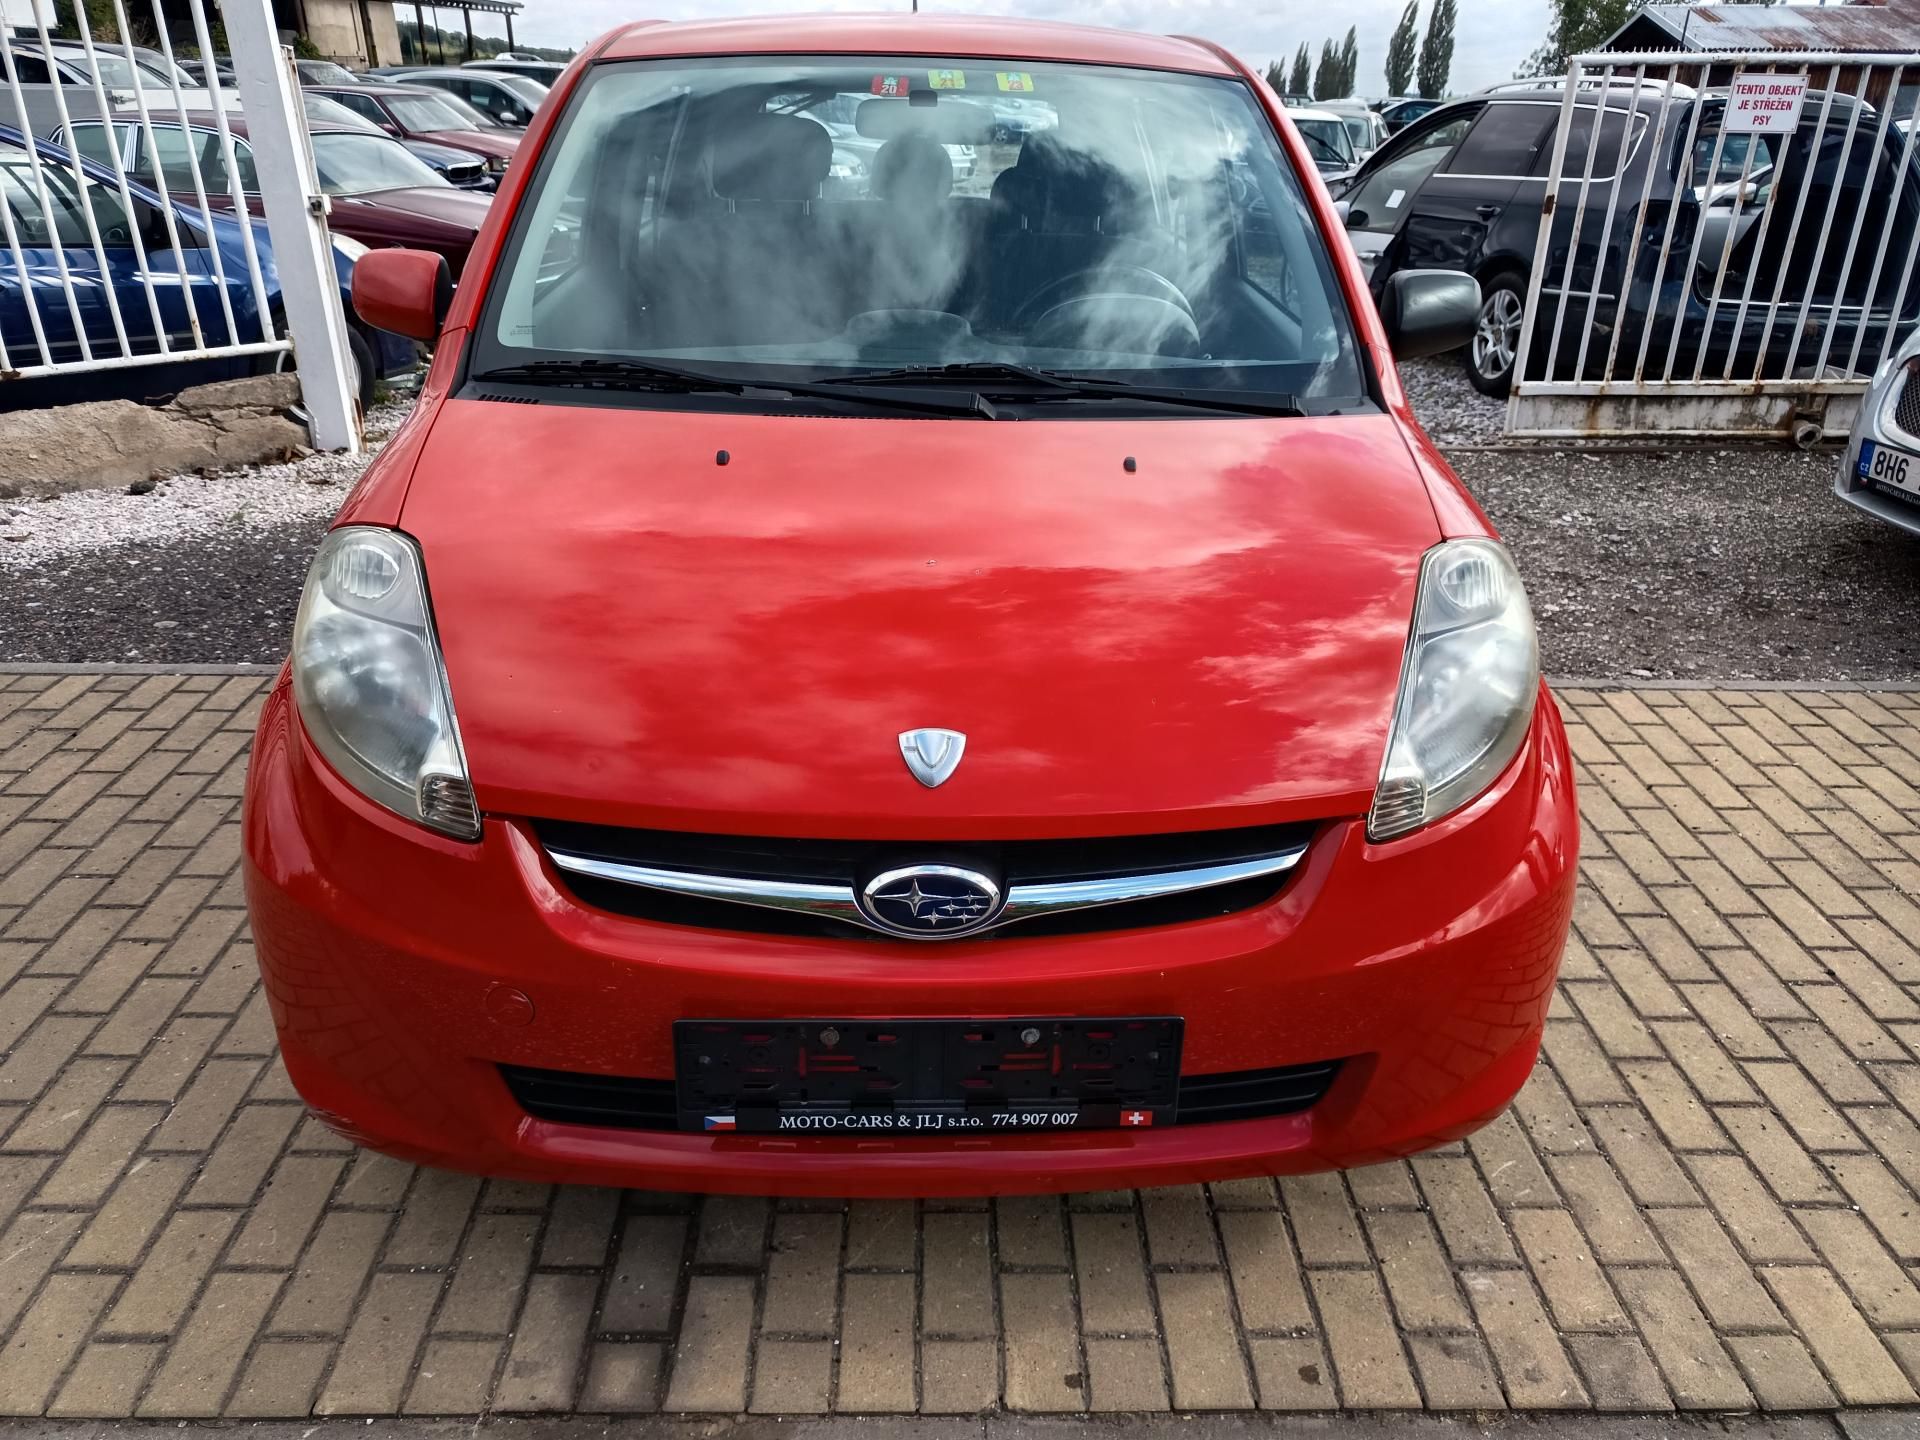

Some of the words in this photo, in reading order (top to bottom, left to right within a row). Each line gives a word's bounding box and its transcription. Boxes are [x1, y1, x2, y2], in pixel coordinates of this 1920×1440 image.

[881, 84, 897, 93] 20
[1736, 84, 1766, 95] TENTO
[1768, 85, 1804, 96] OBJEKT
[1738, 99, 1750, 110] JE
[1752, 97, 1793, 111] STŘEŽEN
[1752, 115, 1772, 125] PSY
[1860, 462, 1869, 472] CZ
[1874, 450, 1910, 484] 8H6
[779, 1115, 893, 1129] MOTO-CARS
[897, 1114, 911, 1127] &
[915, 1114, 944, 1129] JLJ
[947, 1117, 984, 1127] s.r.o.
[992, 1113, 1018, 1126] 774
[1021, 1113, 1048, 1125] 907
[1051, 1113, 1078, 1125] 007
